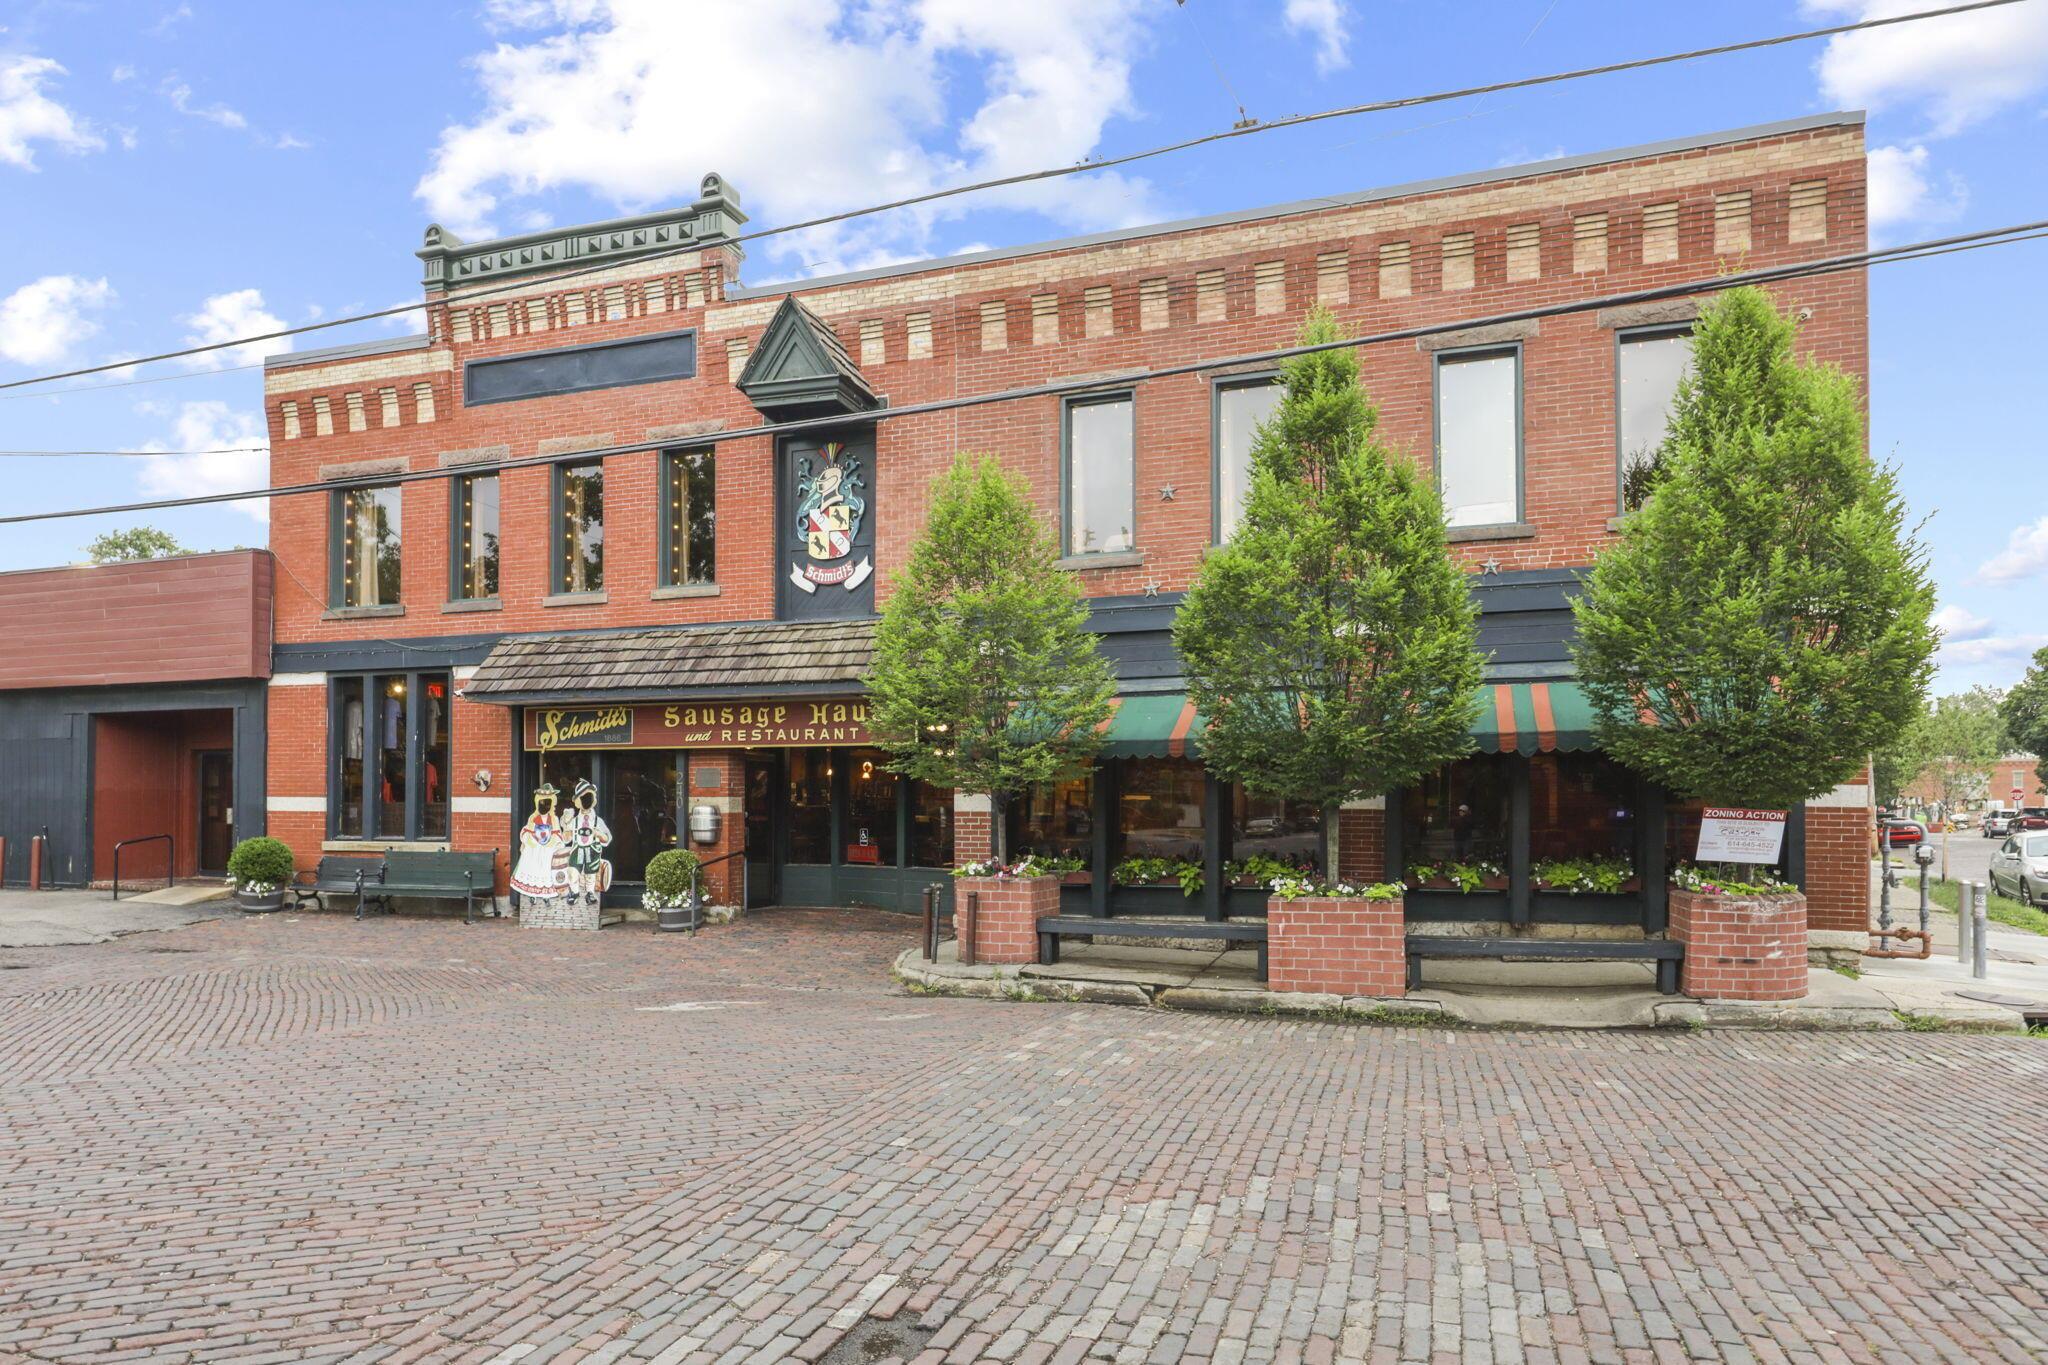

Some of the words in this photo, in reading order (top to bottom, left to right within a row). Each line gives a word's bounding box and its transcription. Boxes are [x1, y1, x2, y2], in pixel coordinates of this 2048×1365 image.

[807, 564, 855, 581] Schmidt's
[664, 705, 787, 728] Sausage
[540, 707, 627, 754] Schmidt's
[685, 730, 712, 742] und
[721, 728, 859, 741] RESTAURANT
[676, 772, 684, 809] 240
[1705, 809, 1744, 818] ZONING
[1745, 811, 1785, 820] ACTION
